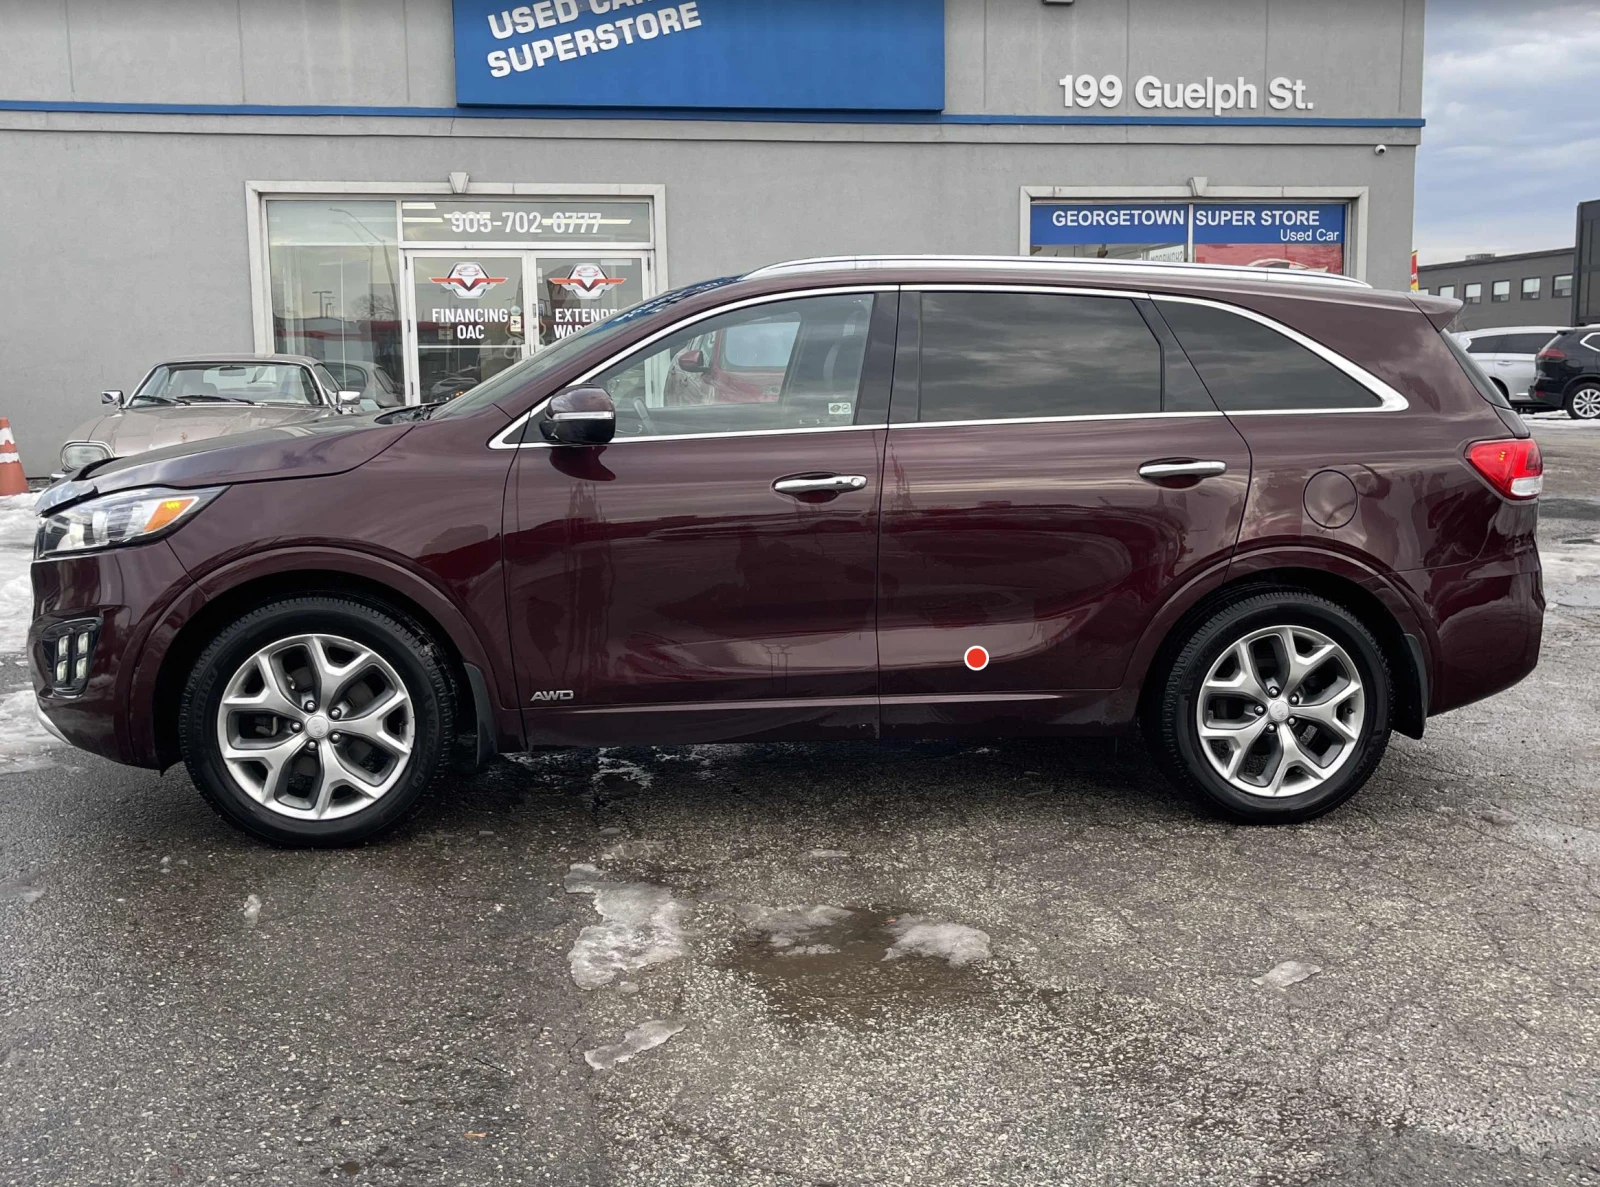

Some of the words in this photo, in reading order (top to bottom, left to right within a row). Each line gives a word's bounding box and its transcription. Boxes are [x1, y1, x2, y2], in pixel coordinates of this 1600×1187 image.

[487, 0, 579, 39] USED
[487, 2, 702, 78] SUPERSTORE
[1059, 74, 1123, 108] 199
[1135, 75, 1257, 116] Guelph
[1268, 76, 1314, 110] St.
[451, 211, 602, 233] 905-702-6777
[1052, 210, 1184, 227] GEORGETOWN
[1195, 210, 1255, 226] SUPER
[1261, 210, 1320, 226] STORE
[1280, 229, 1312, 242] Used
[1316, 229, 1340, 242] Car
[432, 308, 508, 323] FINANCING
[555, 308, 621, 322] EXTEND
[457, 324, 485, 339] OAC
[529, 689, 574, 701] AWD
